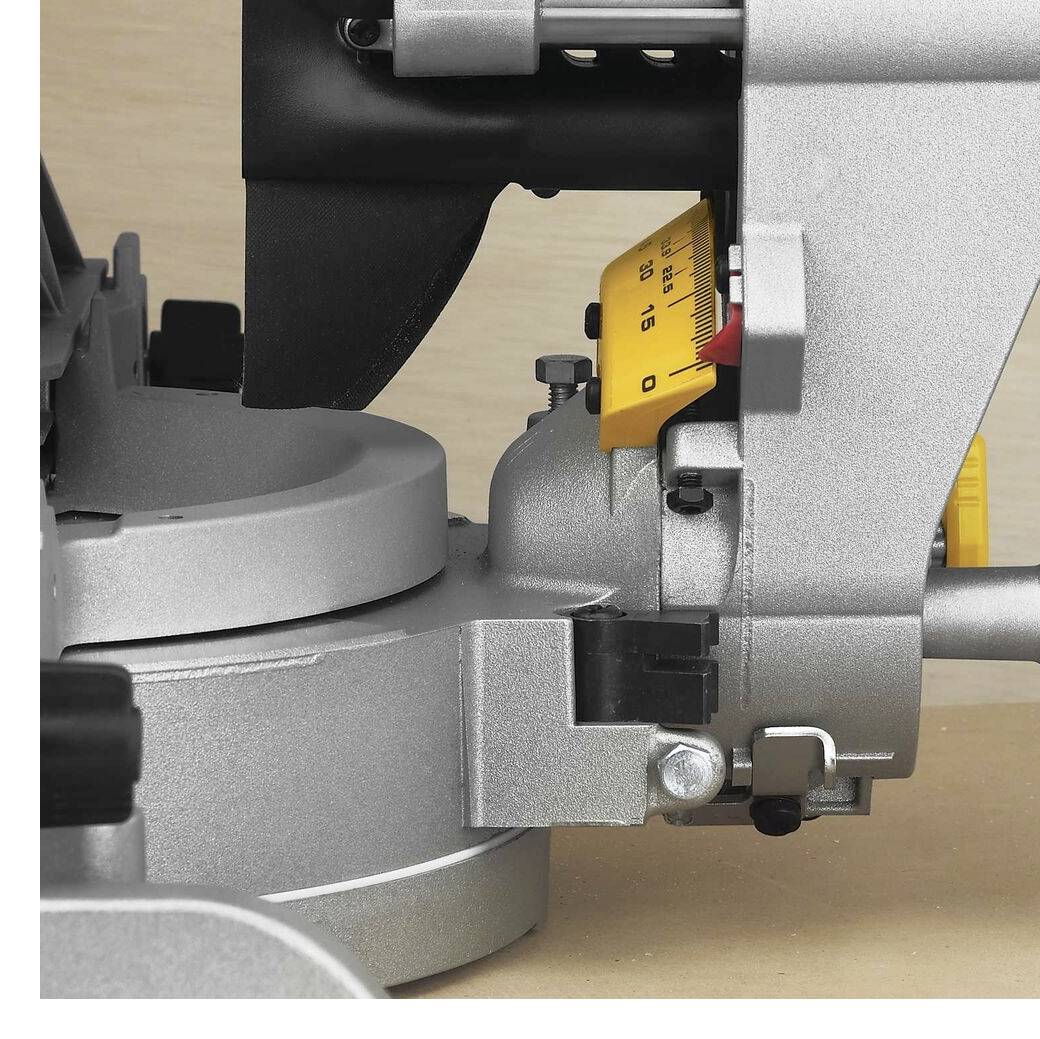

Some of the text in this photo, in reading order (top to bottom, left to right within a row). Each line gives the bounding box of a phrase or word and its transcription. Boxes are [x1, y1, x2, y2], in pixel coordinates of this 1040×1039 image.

[639, 259, 654, 282] 30
[662, 264, 674, 294] 22.5
[641, 303, 656, 332] 15
[641, 374, 657, 393] 0
